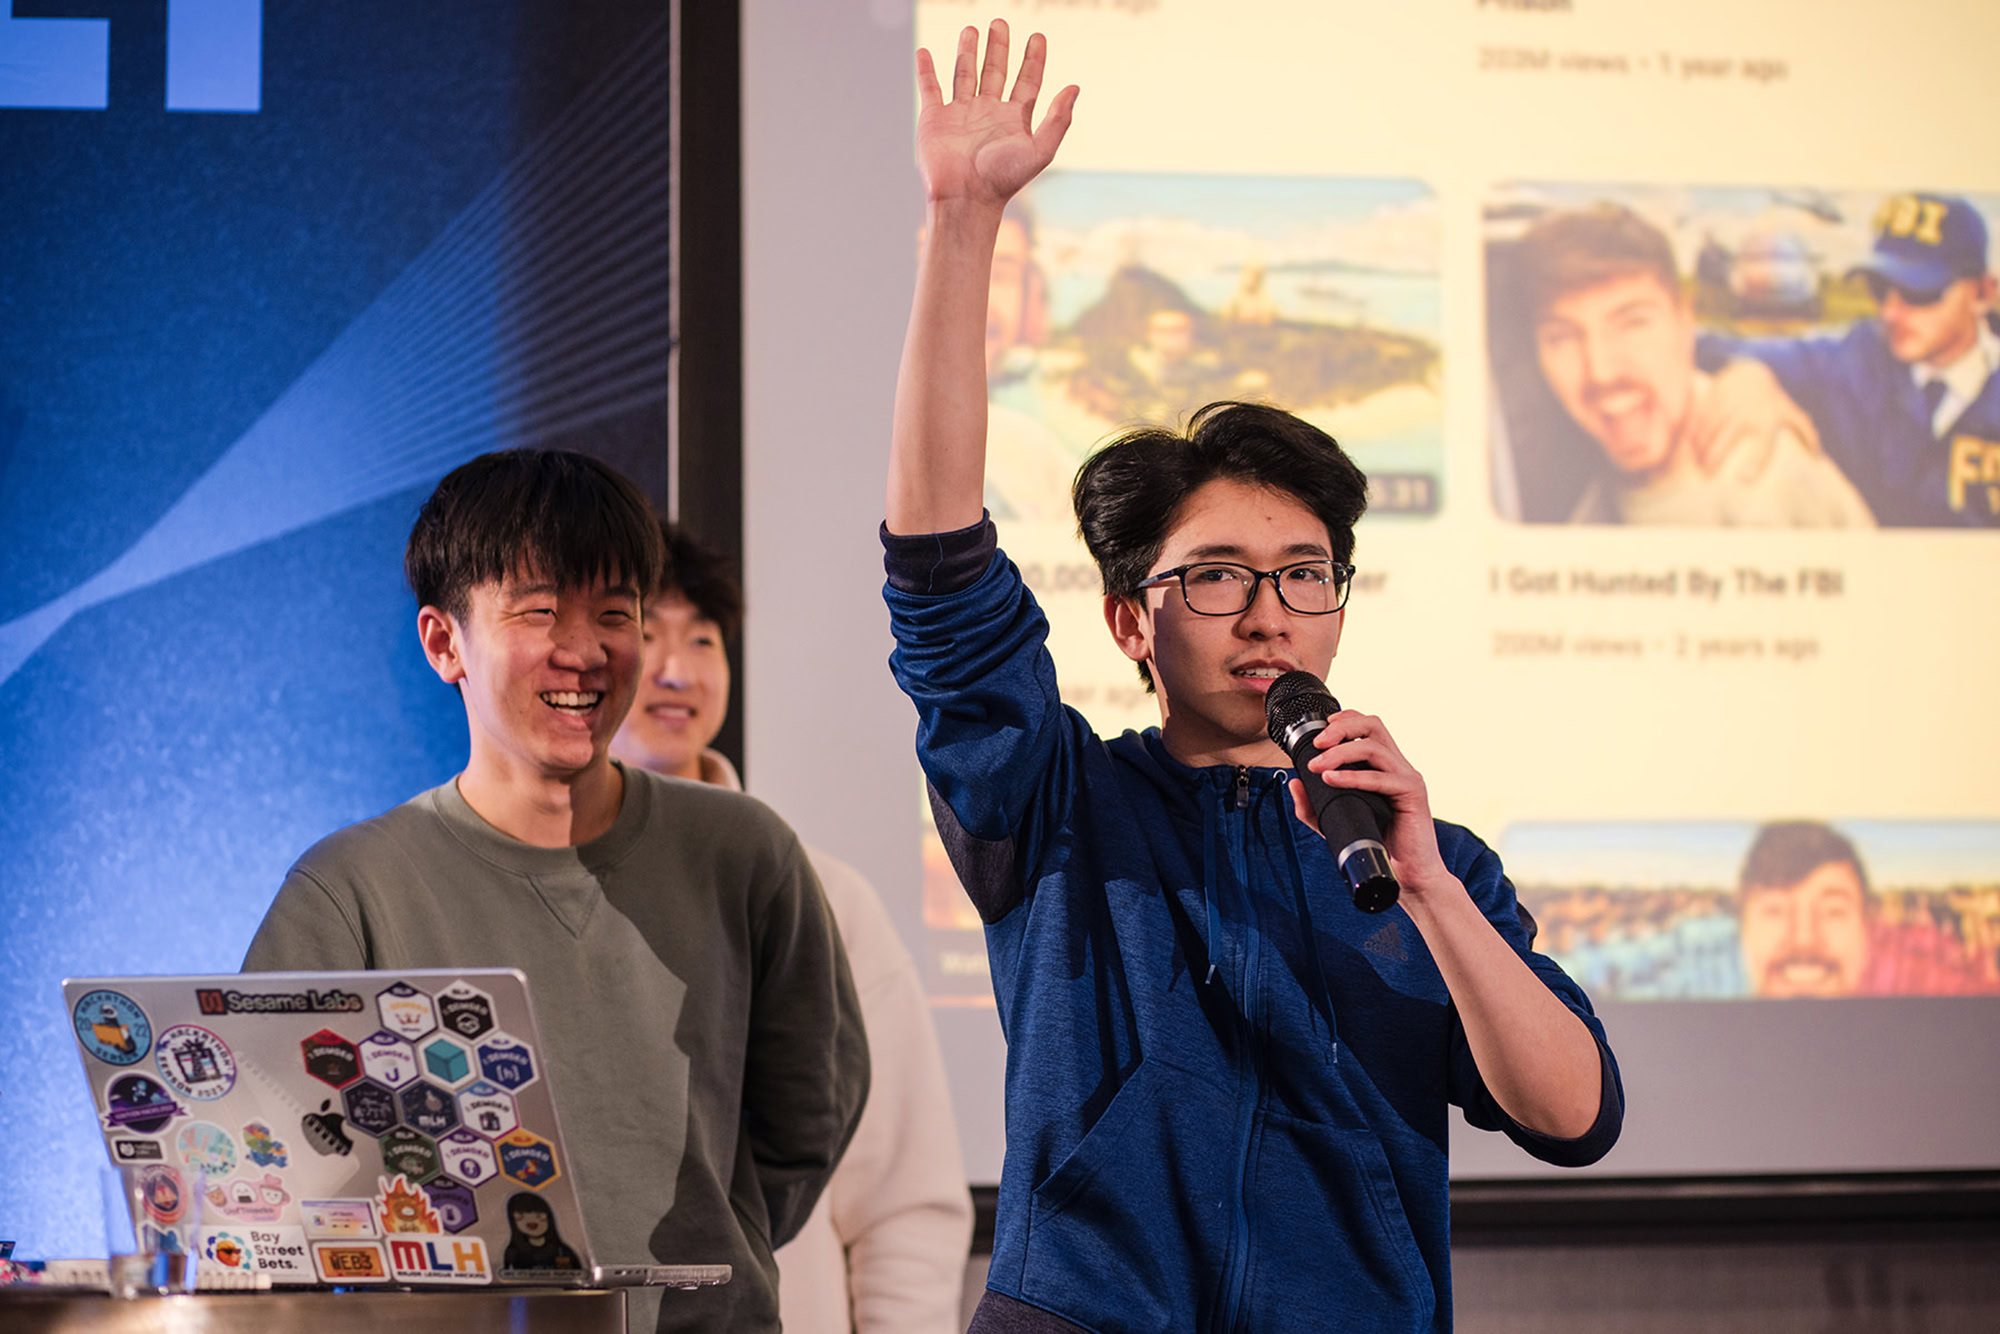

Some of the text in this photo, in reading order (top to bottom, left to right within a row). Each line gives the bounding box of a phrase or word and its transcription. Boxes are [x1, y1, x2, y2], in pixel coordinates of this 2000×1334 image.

[1489, 567, 1844, 601] I Got Hunted By The FBI
[227, 991, 362, 1010] Sesame Labs
[250, 1231, 280, 1245] Bay
[254, 1244, 304, 1256] Street
[390, 1241, 485, 1273] MLH
[257, 1258, 298, 1270] Bets.
[329, 1254, 373, 1271] WEB3
